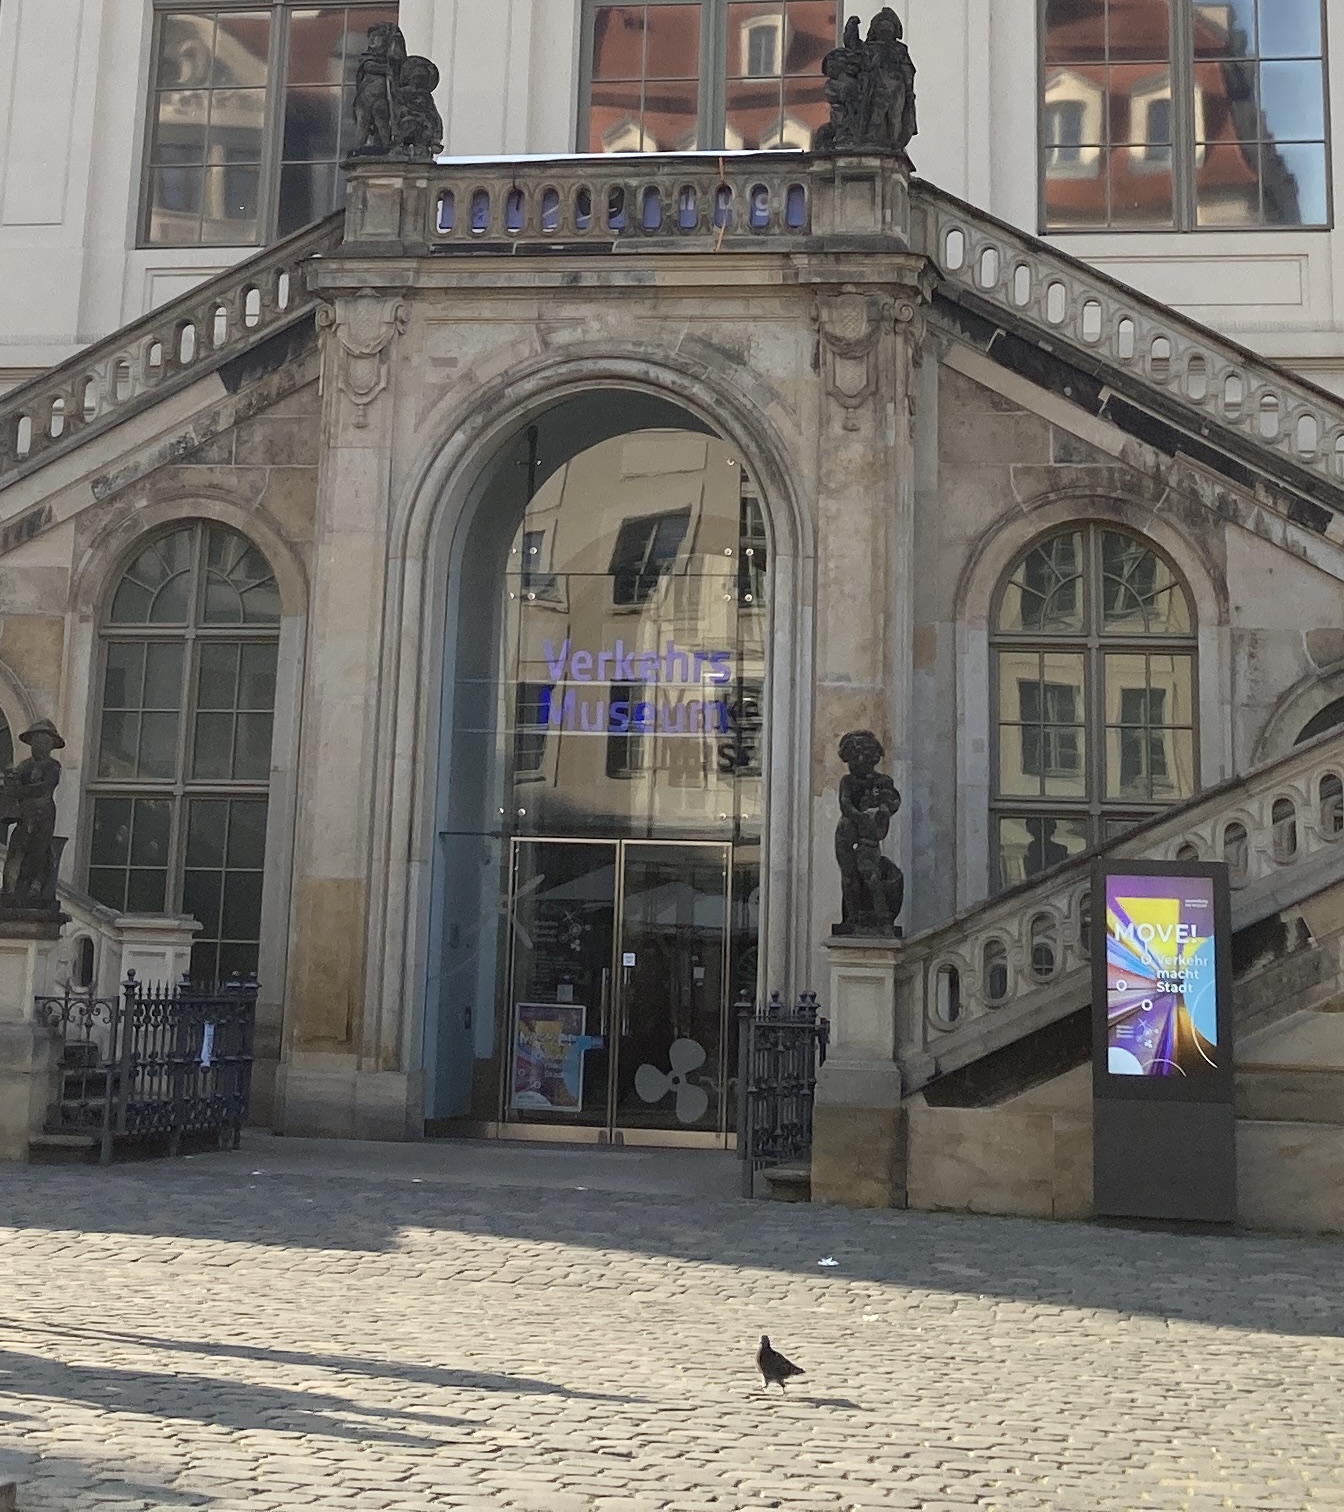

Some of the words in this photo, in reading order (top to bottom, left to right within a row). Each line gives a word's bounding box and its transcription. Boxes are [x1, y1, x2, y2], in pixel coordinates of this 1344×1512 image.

[542, 638, 732, 684] Verkehrs
[538, 685, 729, 734] Museum
[1114, 922, 1198, 944] MOVE!
[1156, 953, 1209, 967] Verkehr
[1156, 968, 1200, 980] macht
[1156, 981, 1194, 994] Stadt
